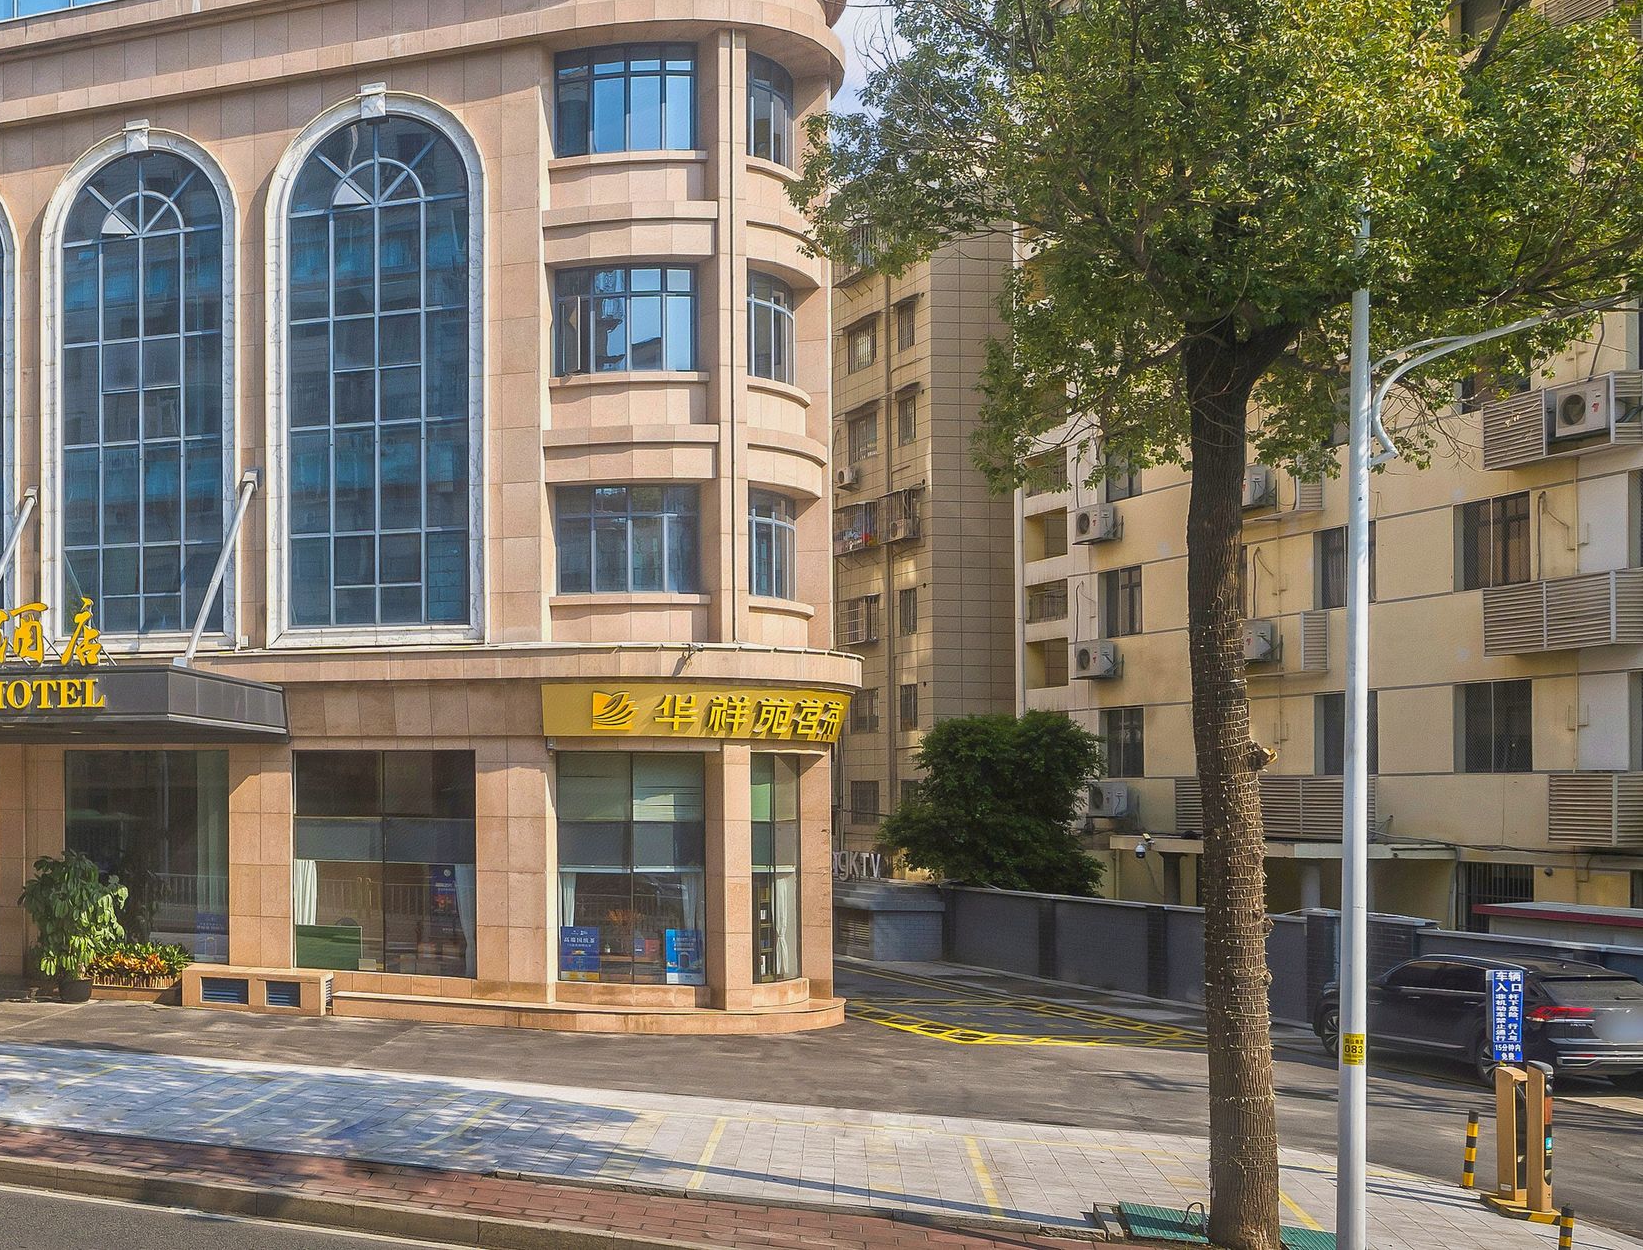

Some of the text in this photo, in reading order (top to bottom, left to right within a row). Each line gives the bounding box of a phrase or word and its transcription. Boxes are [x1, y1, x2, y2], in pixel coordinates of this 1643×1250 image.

[1495, 971, 1521, 982] 车辆
[1495, 982, 1522, 992] 入口
[1344, 1044, 1363, 1054] 083
